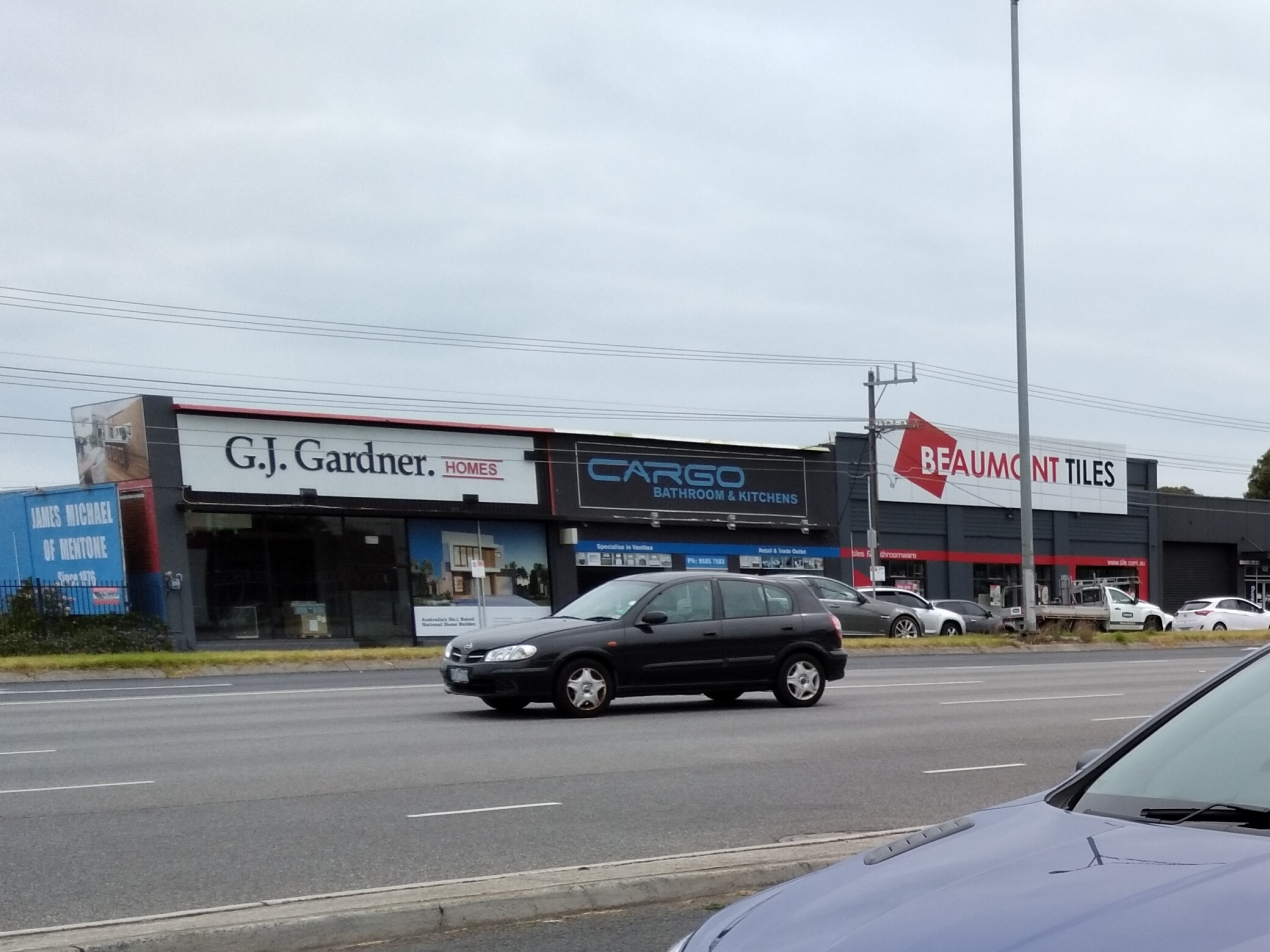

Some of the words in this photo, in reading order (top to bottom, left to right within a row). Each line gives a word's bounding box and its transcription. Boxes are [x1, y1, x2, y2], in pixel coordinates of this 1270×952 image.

[225, 436, 287, 478] G.J.
[446, 461, 498, 476] HOMES
[588, 458, 745, 488] CARGO
[1065, 458, 1115, 487] TILES
[653, 486, 725, 501] BATHROOM
[727, 490, 736, 501] &
[738, 491, 798, 504] KITCHENS
[31, 504, 61, 529] JAMES
[65, 501, 113, 527] MICHAEL
[43, 539, 55, 561] OF
[59, 536, 108, 560] MENTONE
